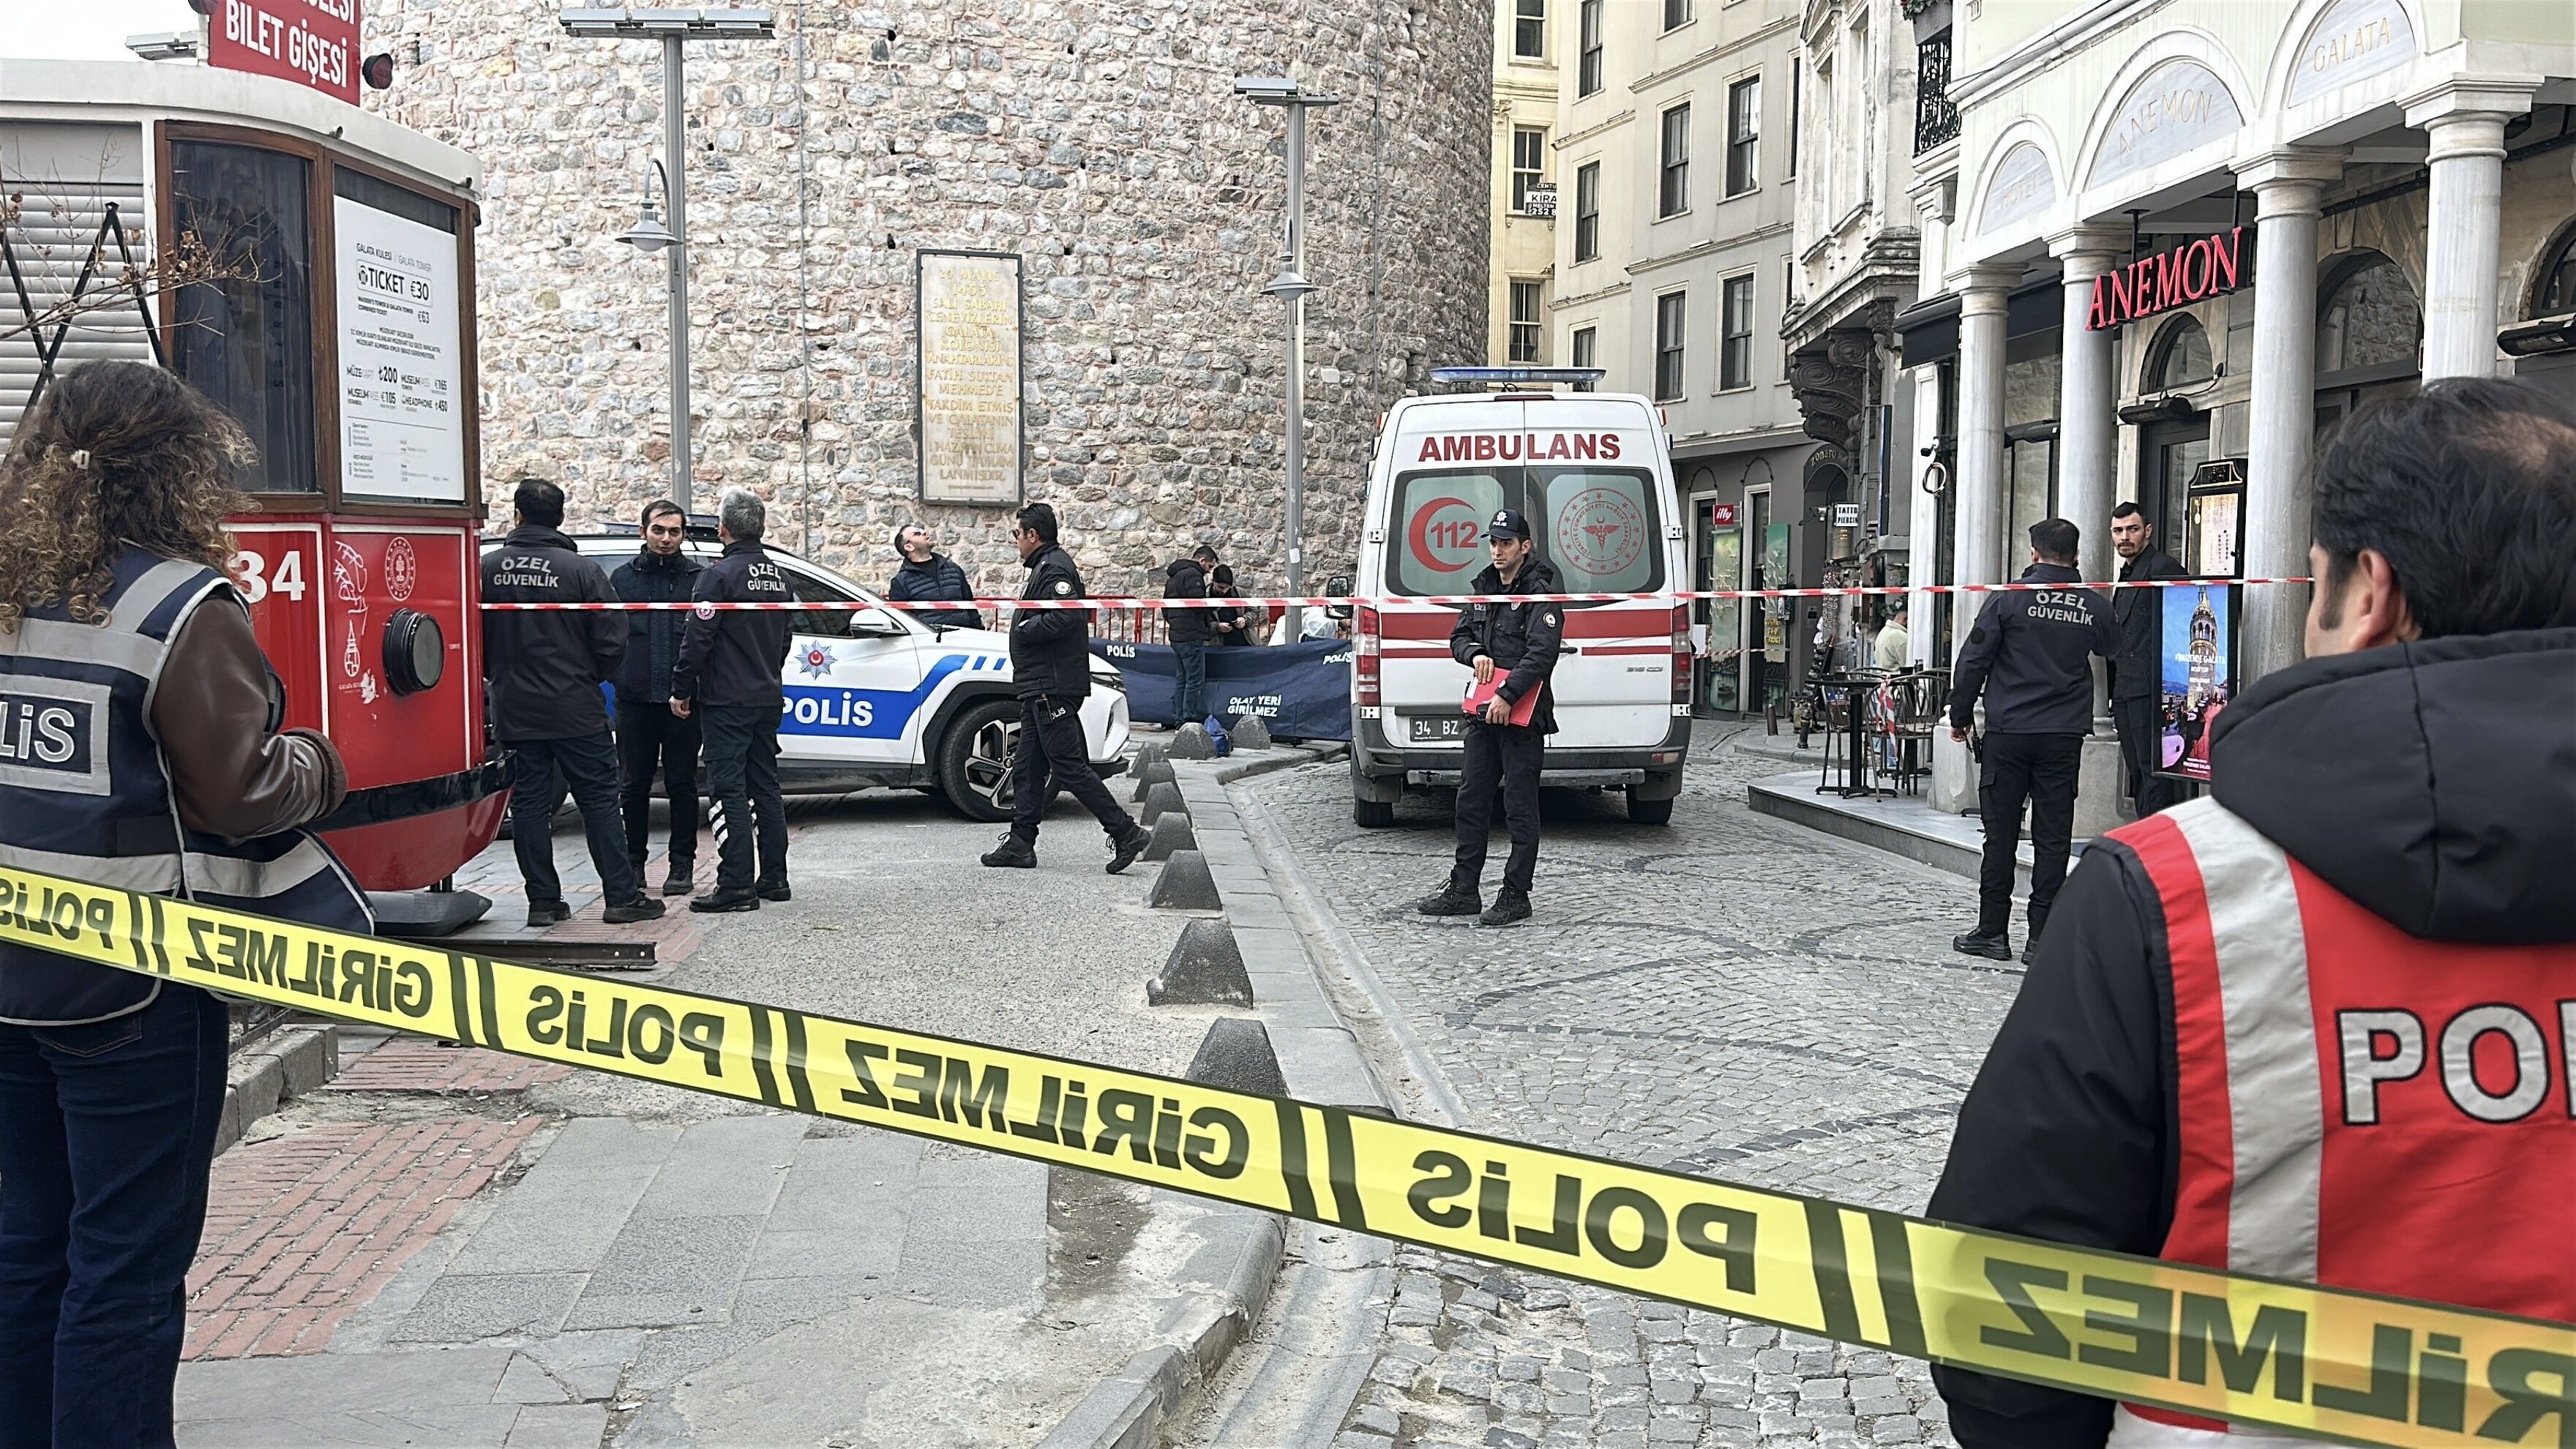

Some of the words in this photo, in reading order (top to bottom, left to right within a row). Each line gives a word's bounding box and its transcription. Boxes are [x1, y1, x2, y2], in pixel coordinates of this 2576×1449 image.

[289, 18, 347, 88] GİŞESİ
[2314, 18, 2389, 72] GALATA
[2120, 89, 2212, 154] ANEMON
[356, 243, 375, 256] GALATA
[368, 267, 404, 294] TICKET
[411, 280, 429, 301] €30
[2086, 226, 2242, 331] ANEMON
[418, 311, 430, 323] €63
[946, 326, 995, 338] GALATA
[1418, 433, 1621, 462] AMBULANS
[1811, 449, 1837, 467] zonaro
[1716, 507, 1732, 521] illy
[1430, 520, 1478, 548] 112
[501, 556, 552, 573] ÖZEL
[748, 563, 782, 579] ÖZEL
[227, 550, 306, 604] 34
[493, 572, 559, 588] GÜVENLİK
[2036, 590, 2087, 611] ÖZEL
[2027, 604, 2093, 626] GÜVENLİK
[1107, 645, 1135, 658] POLİS
[1229, 697, 1255, 705] OLAY
[1258, 694, 1282, 706] YERİ
[1227, 703, 1278, 717] GİRİLMEZ
[1415, 720, 1431, 735] 34
[1442, 720, 1459, 735] BZ
[2334, 999, 2576, 1126] PO
